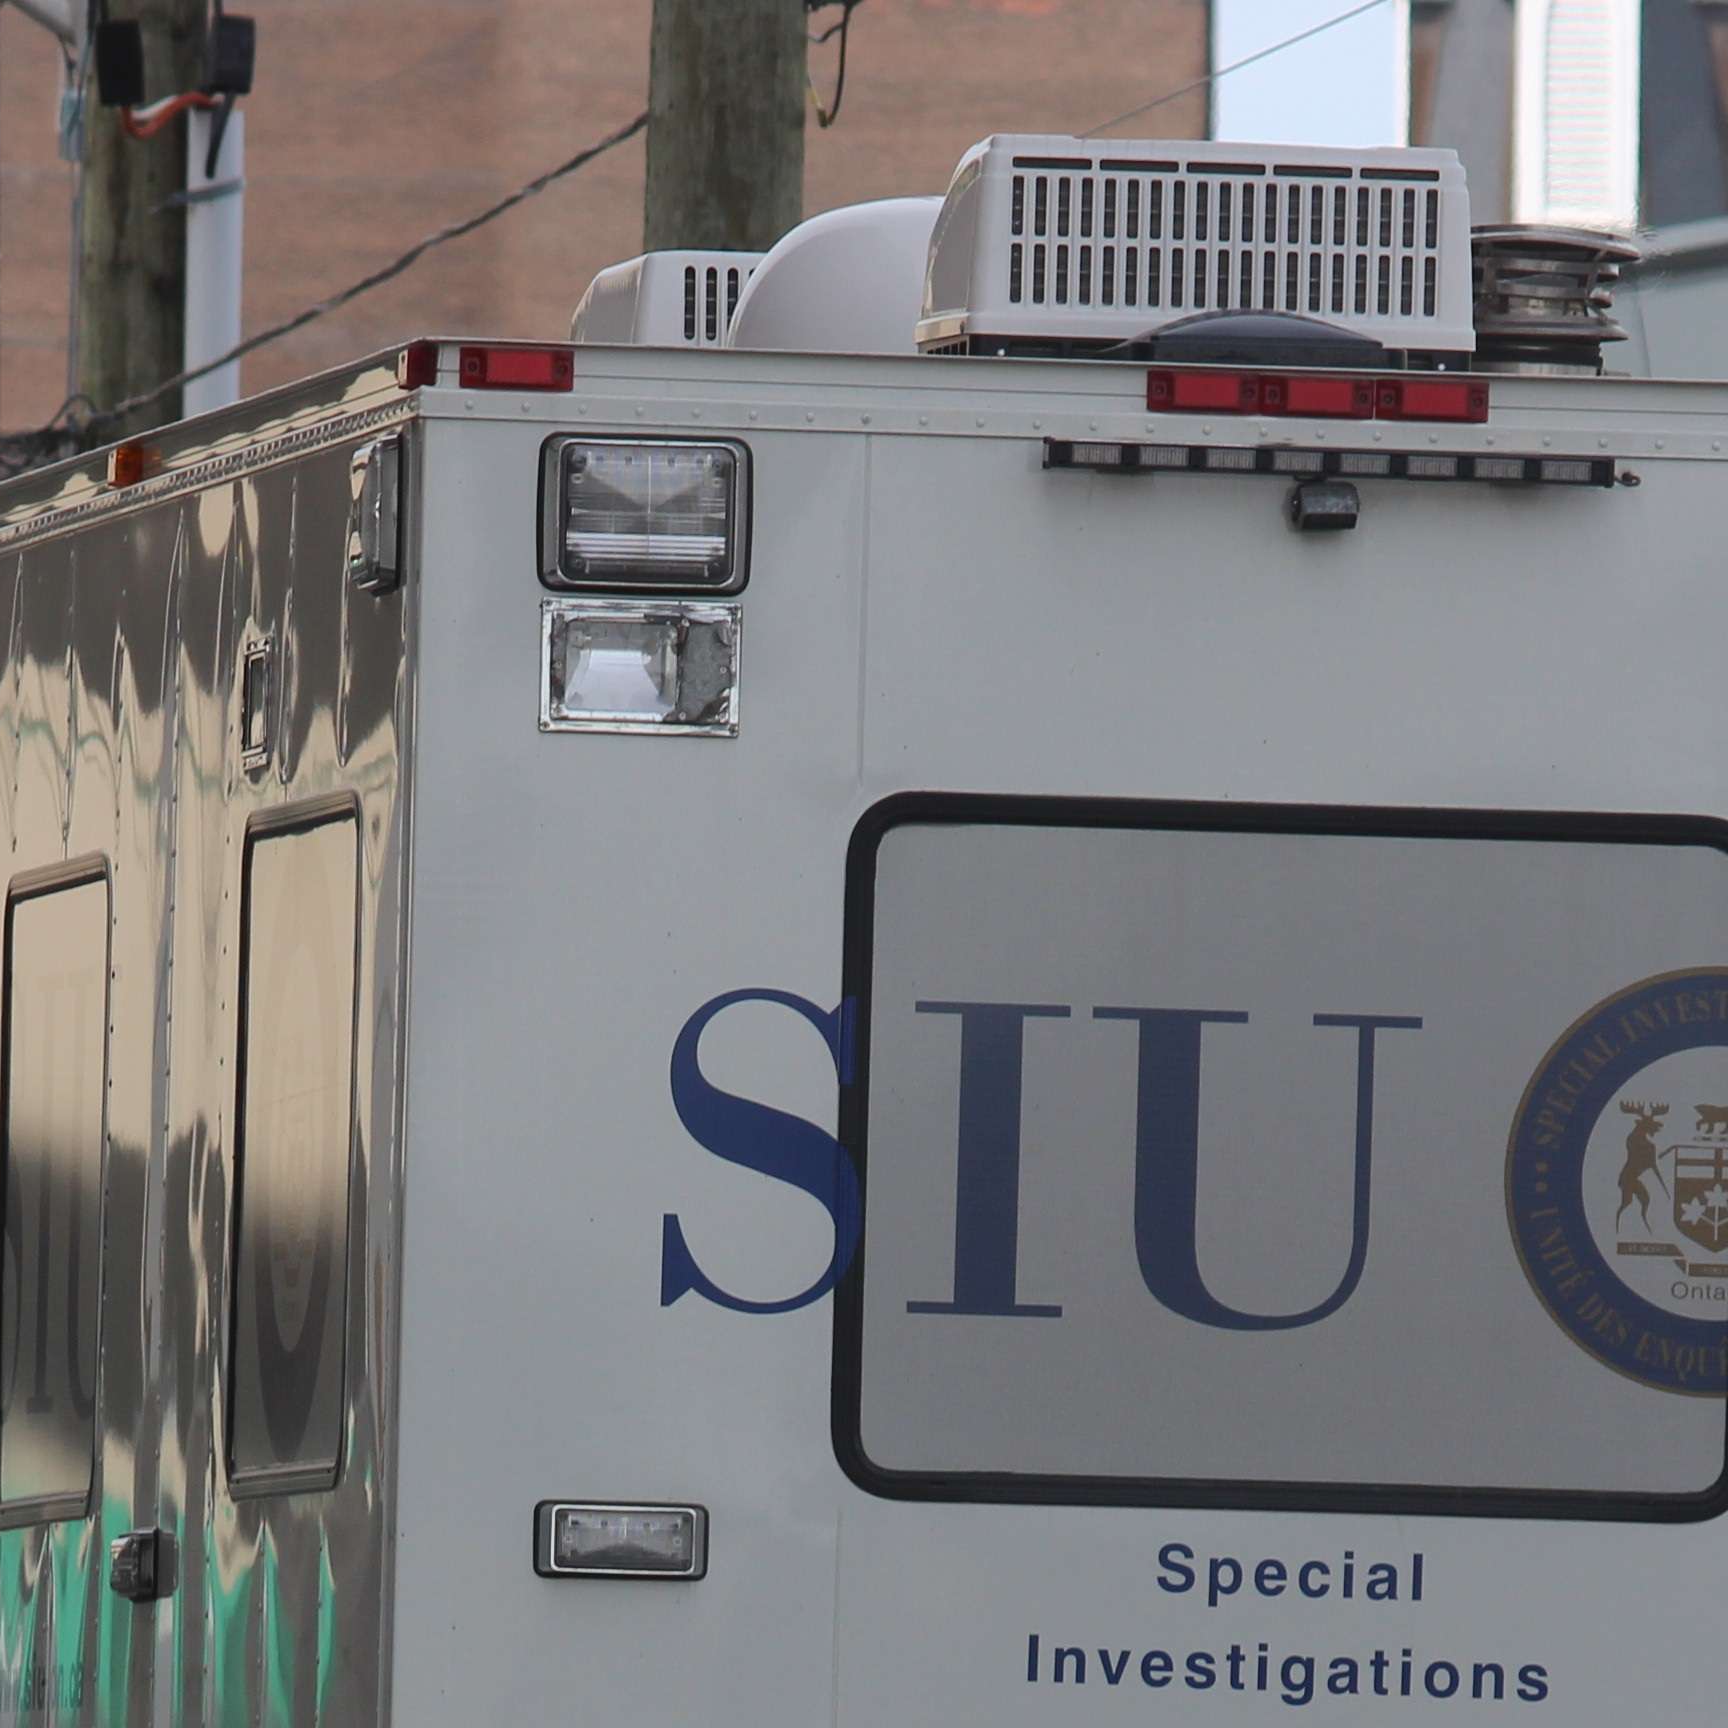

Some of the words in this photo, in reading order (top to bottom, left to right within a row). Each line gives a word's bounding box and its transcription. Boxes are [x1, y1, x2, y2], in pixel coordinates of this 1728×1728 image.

[1534, 1035, 1622, 1150] SPECIAL
[660, 987, 1425, 1333] SIU
[1156, 1543, 1424, 1608] Special
[1026, 1634, 1549, 1706] Investigations
